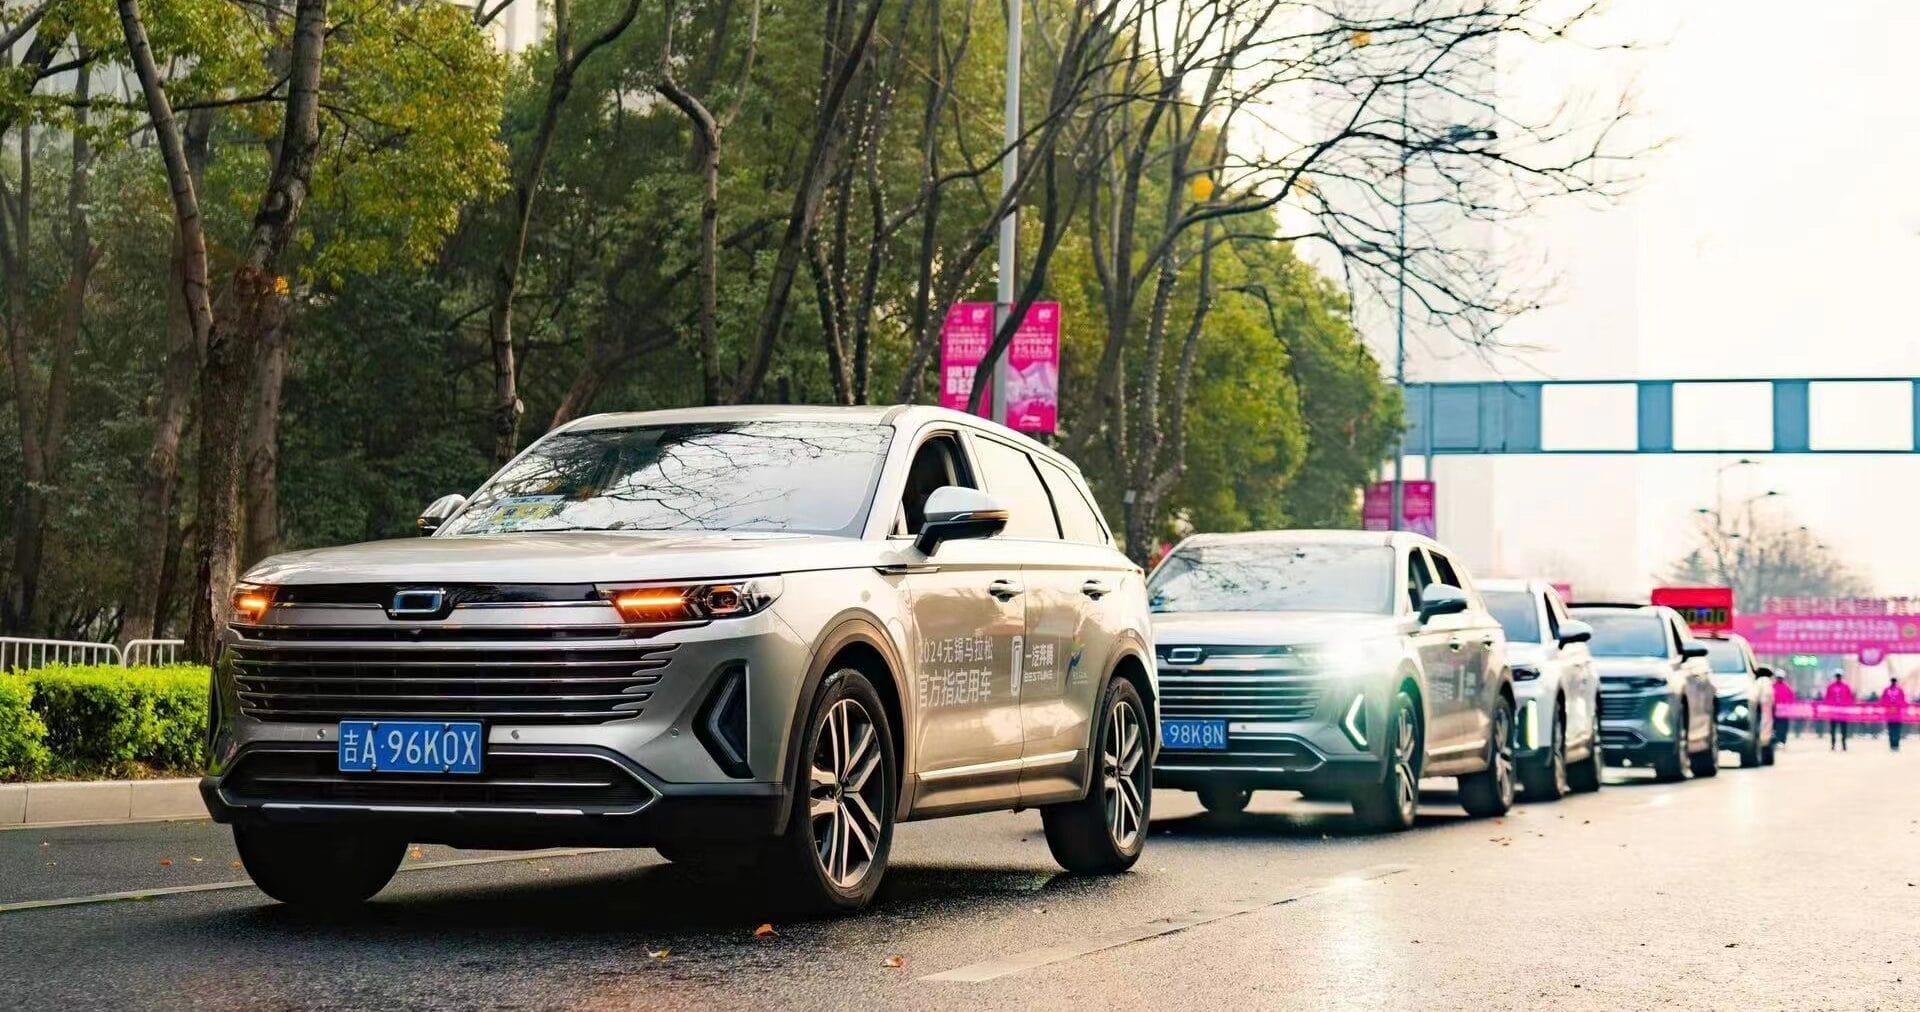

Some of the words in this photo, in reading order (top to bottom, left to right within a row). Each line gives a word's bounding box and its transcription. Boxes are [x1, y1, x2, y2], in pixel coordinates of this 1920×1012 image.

[919, 637, 993, 664] 2024无锡马拉松
[919, 666, 992, 707] 官方指定用车
[1162, 725, 1224, 744] ·98K8N
